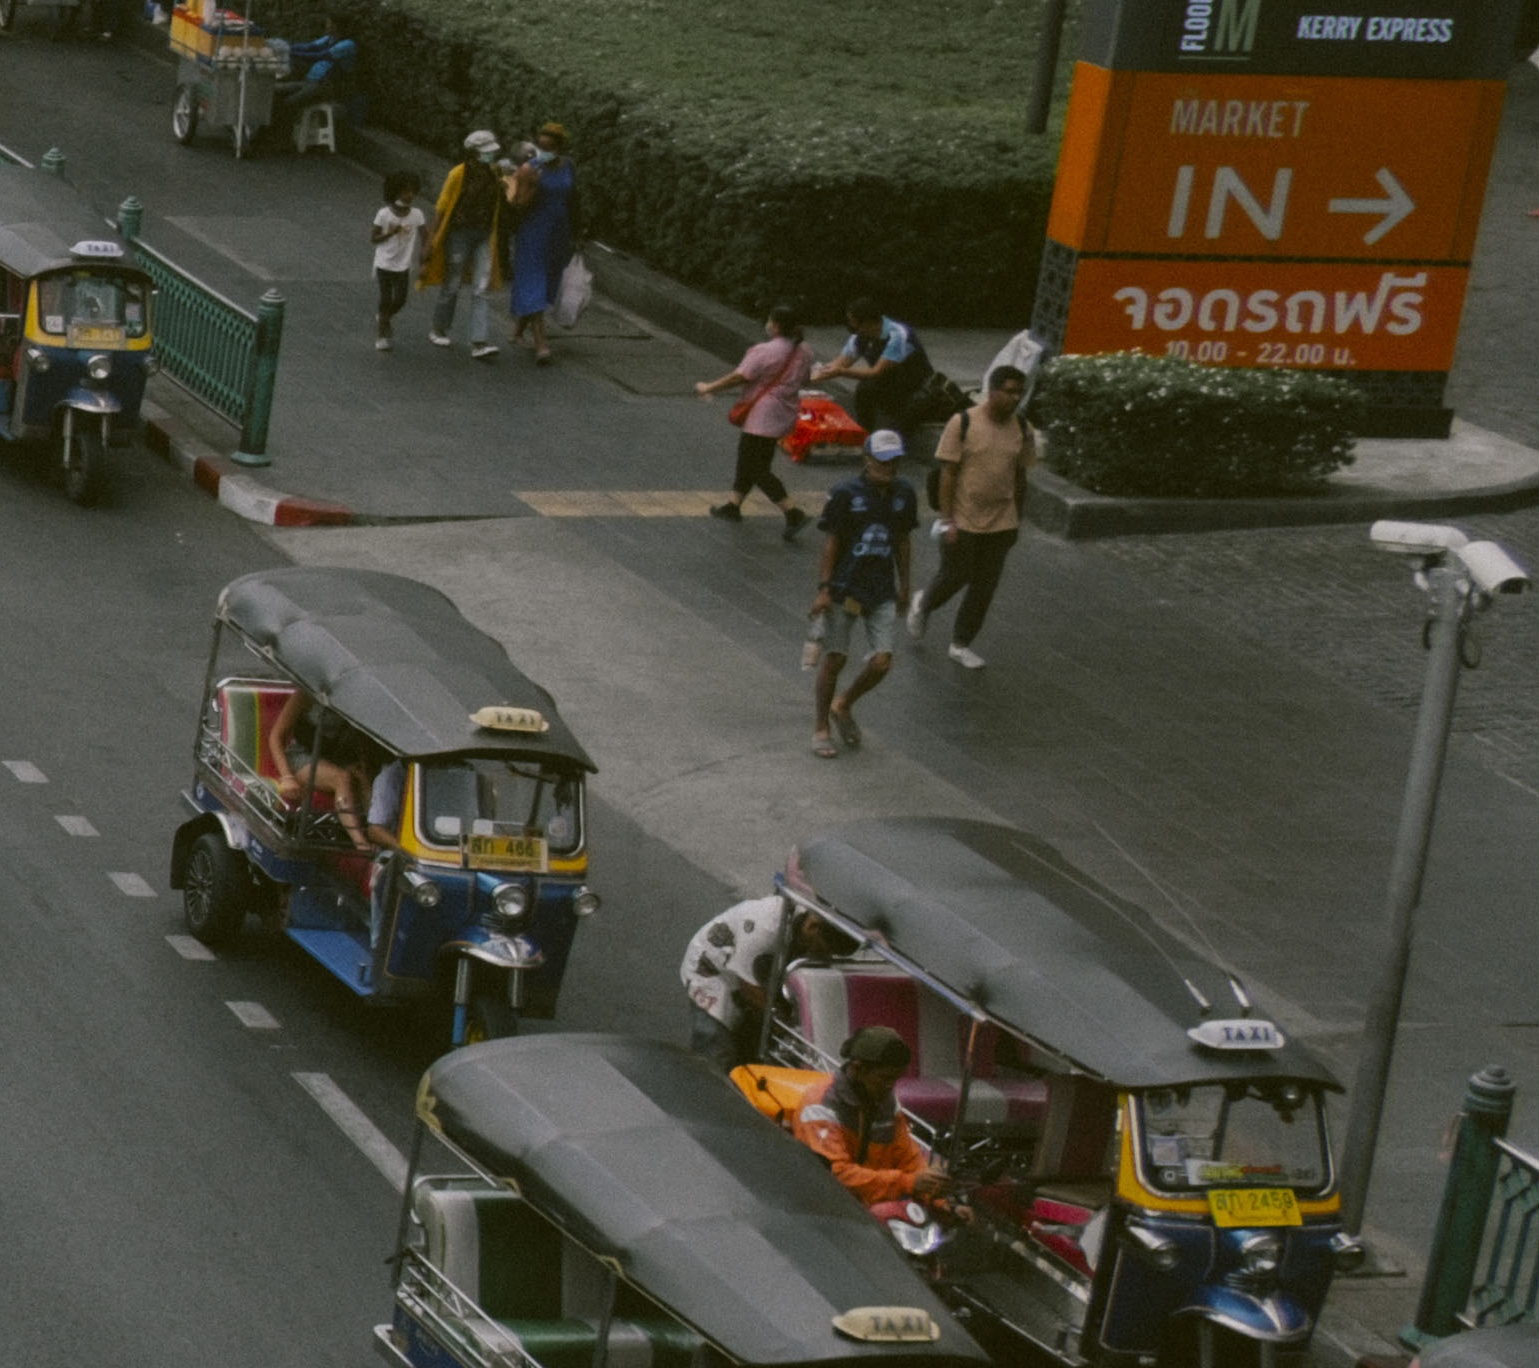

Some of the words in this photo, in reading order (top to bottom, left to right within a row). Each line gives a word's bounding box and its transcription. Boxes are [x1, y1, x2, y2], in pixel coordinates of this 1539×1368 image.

[1296, 15, 1363, 40] KERRY
[1365, 16, 1454, 43] EXPRESS
[1170, 98, 1311, 139] MARKET
[1166, 165, 1292, 241] IN
[1113, 271, 1429, 336] จอดรถฟรี
[1166, 340, 1227, 362] 10.00
[1255, 342, 1324, 364] 22.00
[495, 712, 536, 727] TAXI
[1223, 1026, 1271, 1042] TAXI
[869, 1314, 927, 1333] TAXI
